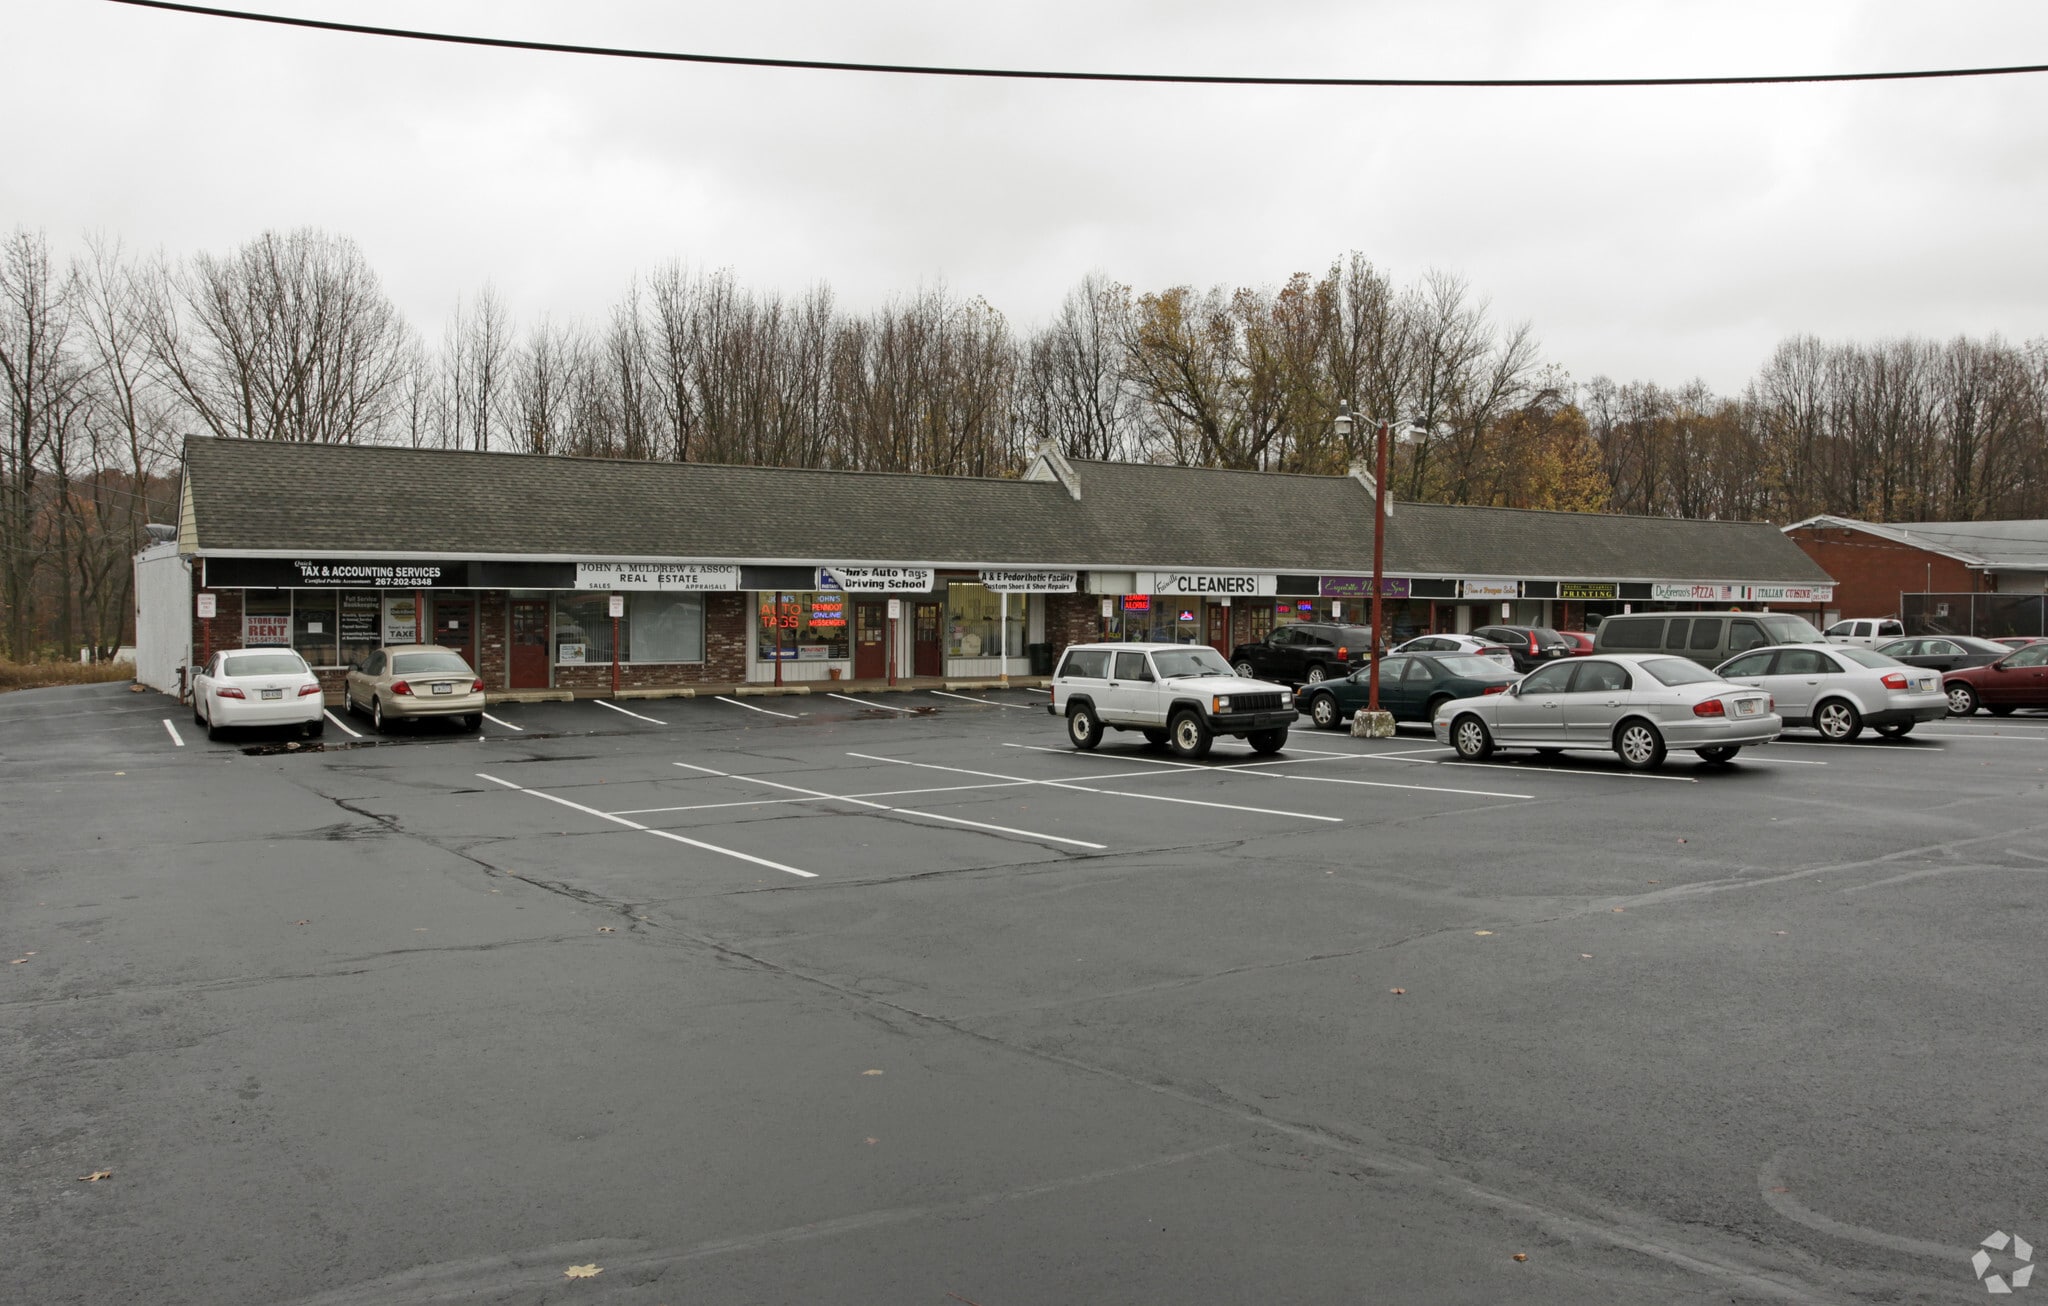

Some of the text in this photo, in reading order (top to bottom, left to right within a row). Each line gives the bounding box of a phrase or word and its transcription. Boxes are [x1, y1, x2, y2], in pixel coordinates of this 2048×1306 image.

[301, 566, 441, 578] TAX & ACCOUNTING SERVICES
[581, 563, 735, 574] JOHN A. MULDREW & ASSOC.
[836, 568, 869, 577] hn's
[872, 568, 898, 577] Auto
[902, 568, 928, 579] Tags
[375, 578, 432, 586] 267-202-6348
[620, 574, 698, 583] REAL ESTATE
[981, 572, 1074, 582] A & E Pedorthotic Facility
[845, 579, 926, 590] Driving School
[983, 582, 1007, 590] Custom
[1048, 583, 1070, 591] Repairs
[1177, 576, 1255, 593] CLEANERS
[1325, 579, 1358, 593] Exquisite
[1691, 585, 1715, 599] PIZZA
[1757, 588, 1784, 598] ITALIAN
[1785, 589, 1811, 599] CUISINE
[812, 611, 842, 619] ONLINE
[808, 619, 847, 627] MESSENGER
[248, 625, 288, 637] RENT
[390, 630, 415, 638] TAXE
